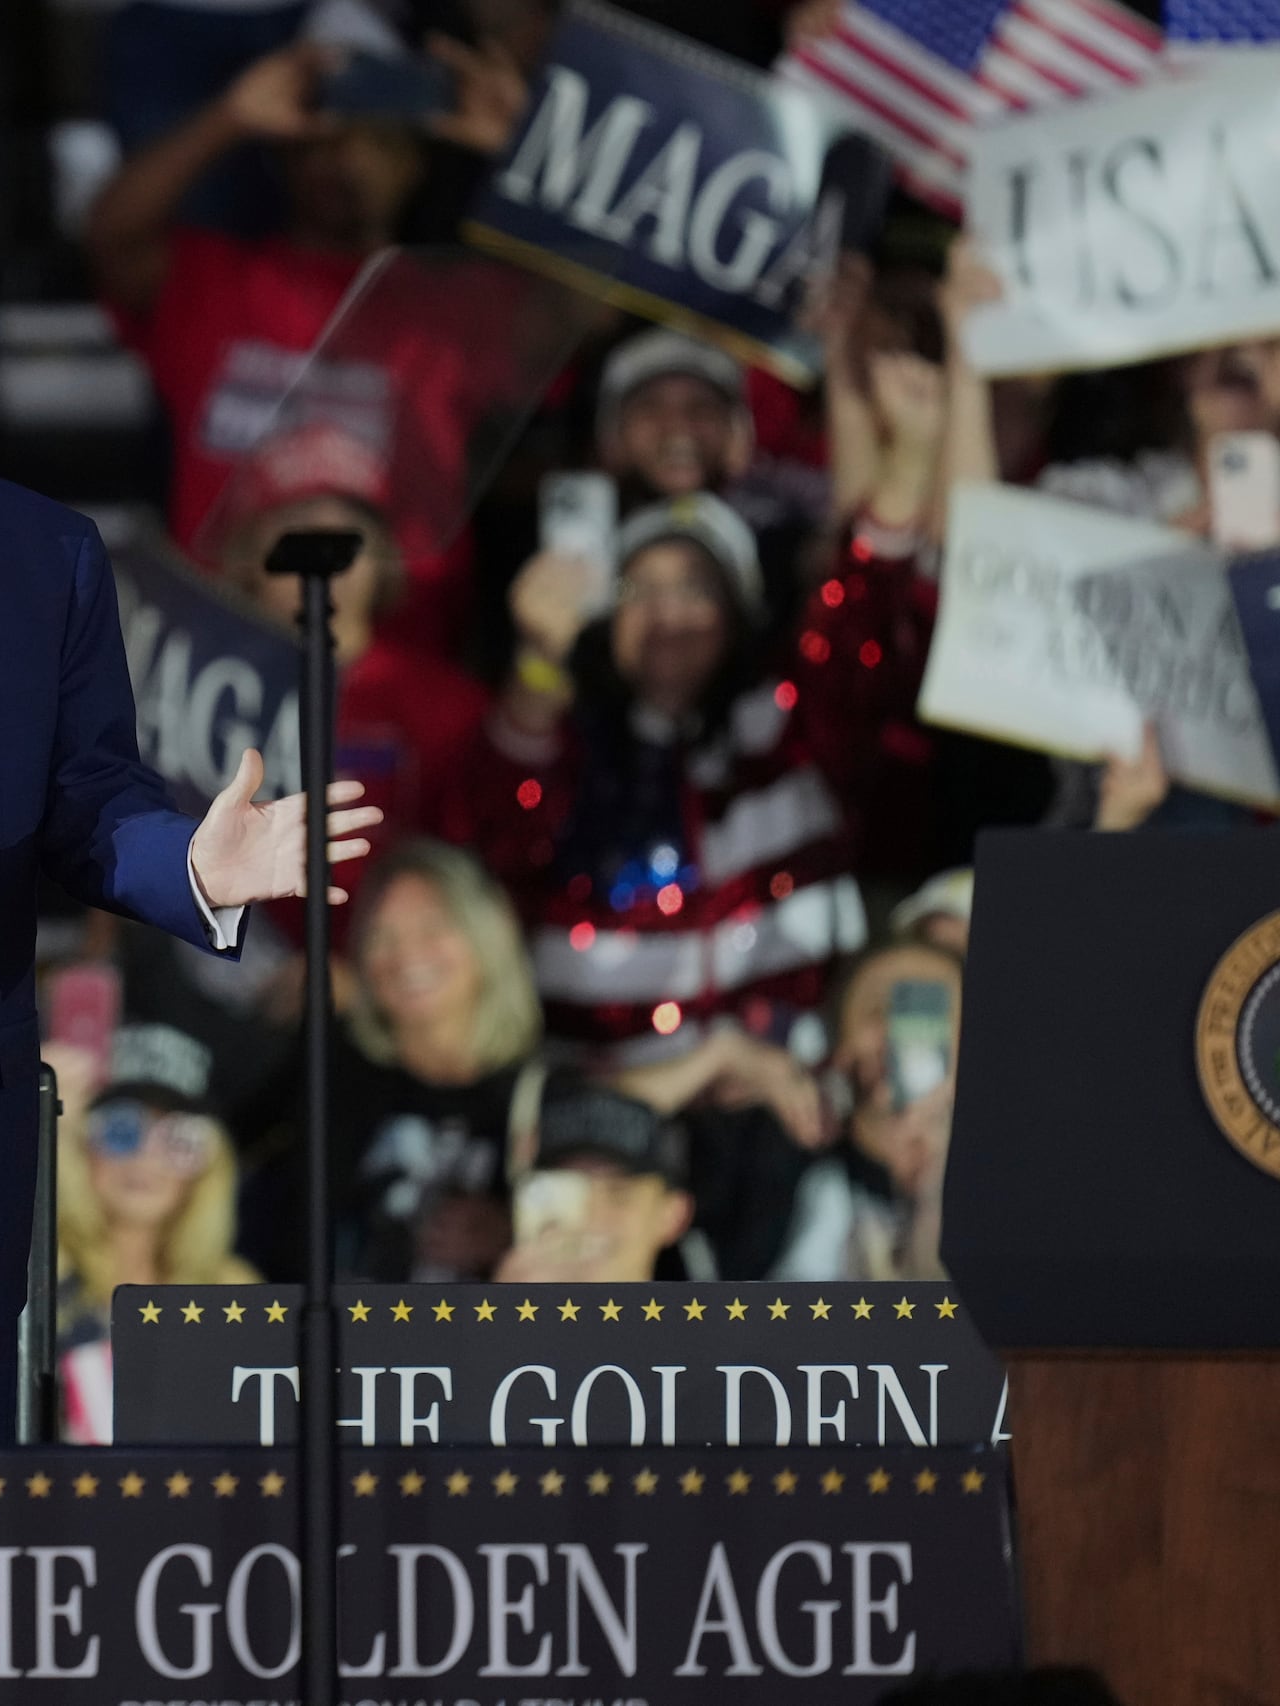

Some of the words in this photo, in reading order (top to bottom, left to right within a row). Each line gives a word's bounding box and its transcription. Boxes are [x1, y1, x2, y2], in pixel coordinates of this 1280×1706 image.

[495, 63, 846, 312] MAGA
[1006, 122, 1276, 312] USA
[489, 1364, 949, 1446] GOLDEN
[675, 1541, 916, 1677] AGE
